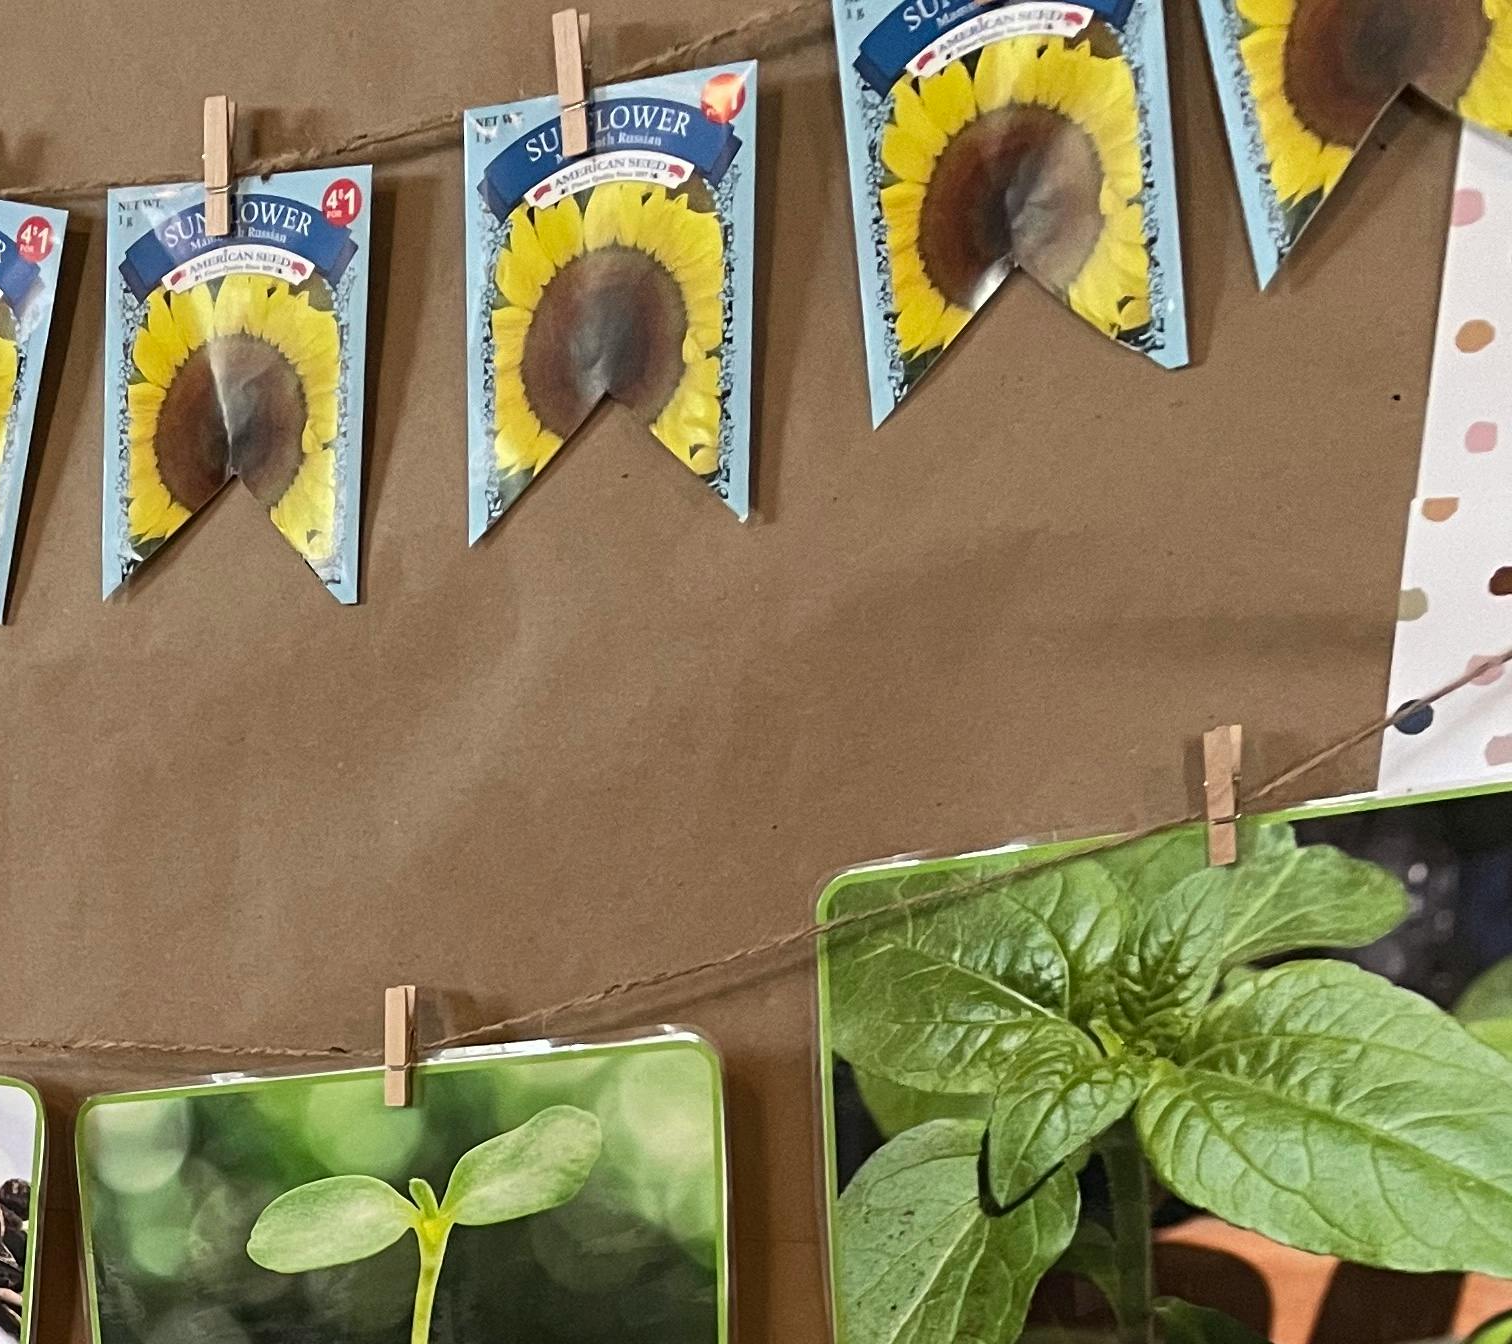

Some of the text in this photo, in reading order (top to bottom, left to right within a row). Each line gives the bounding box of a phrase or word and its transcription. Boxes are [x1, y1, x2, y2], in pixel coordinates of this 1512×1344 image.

[618, 132, 662, 147] Russian
[554, 156, 626, 186] AMERICAN
[189, 249, 254, 275] AMERICAN
